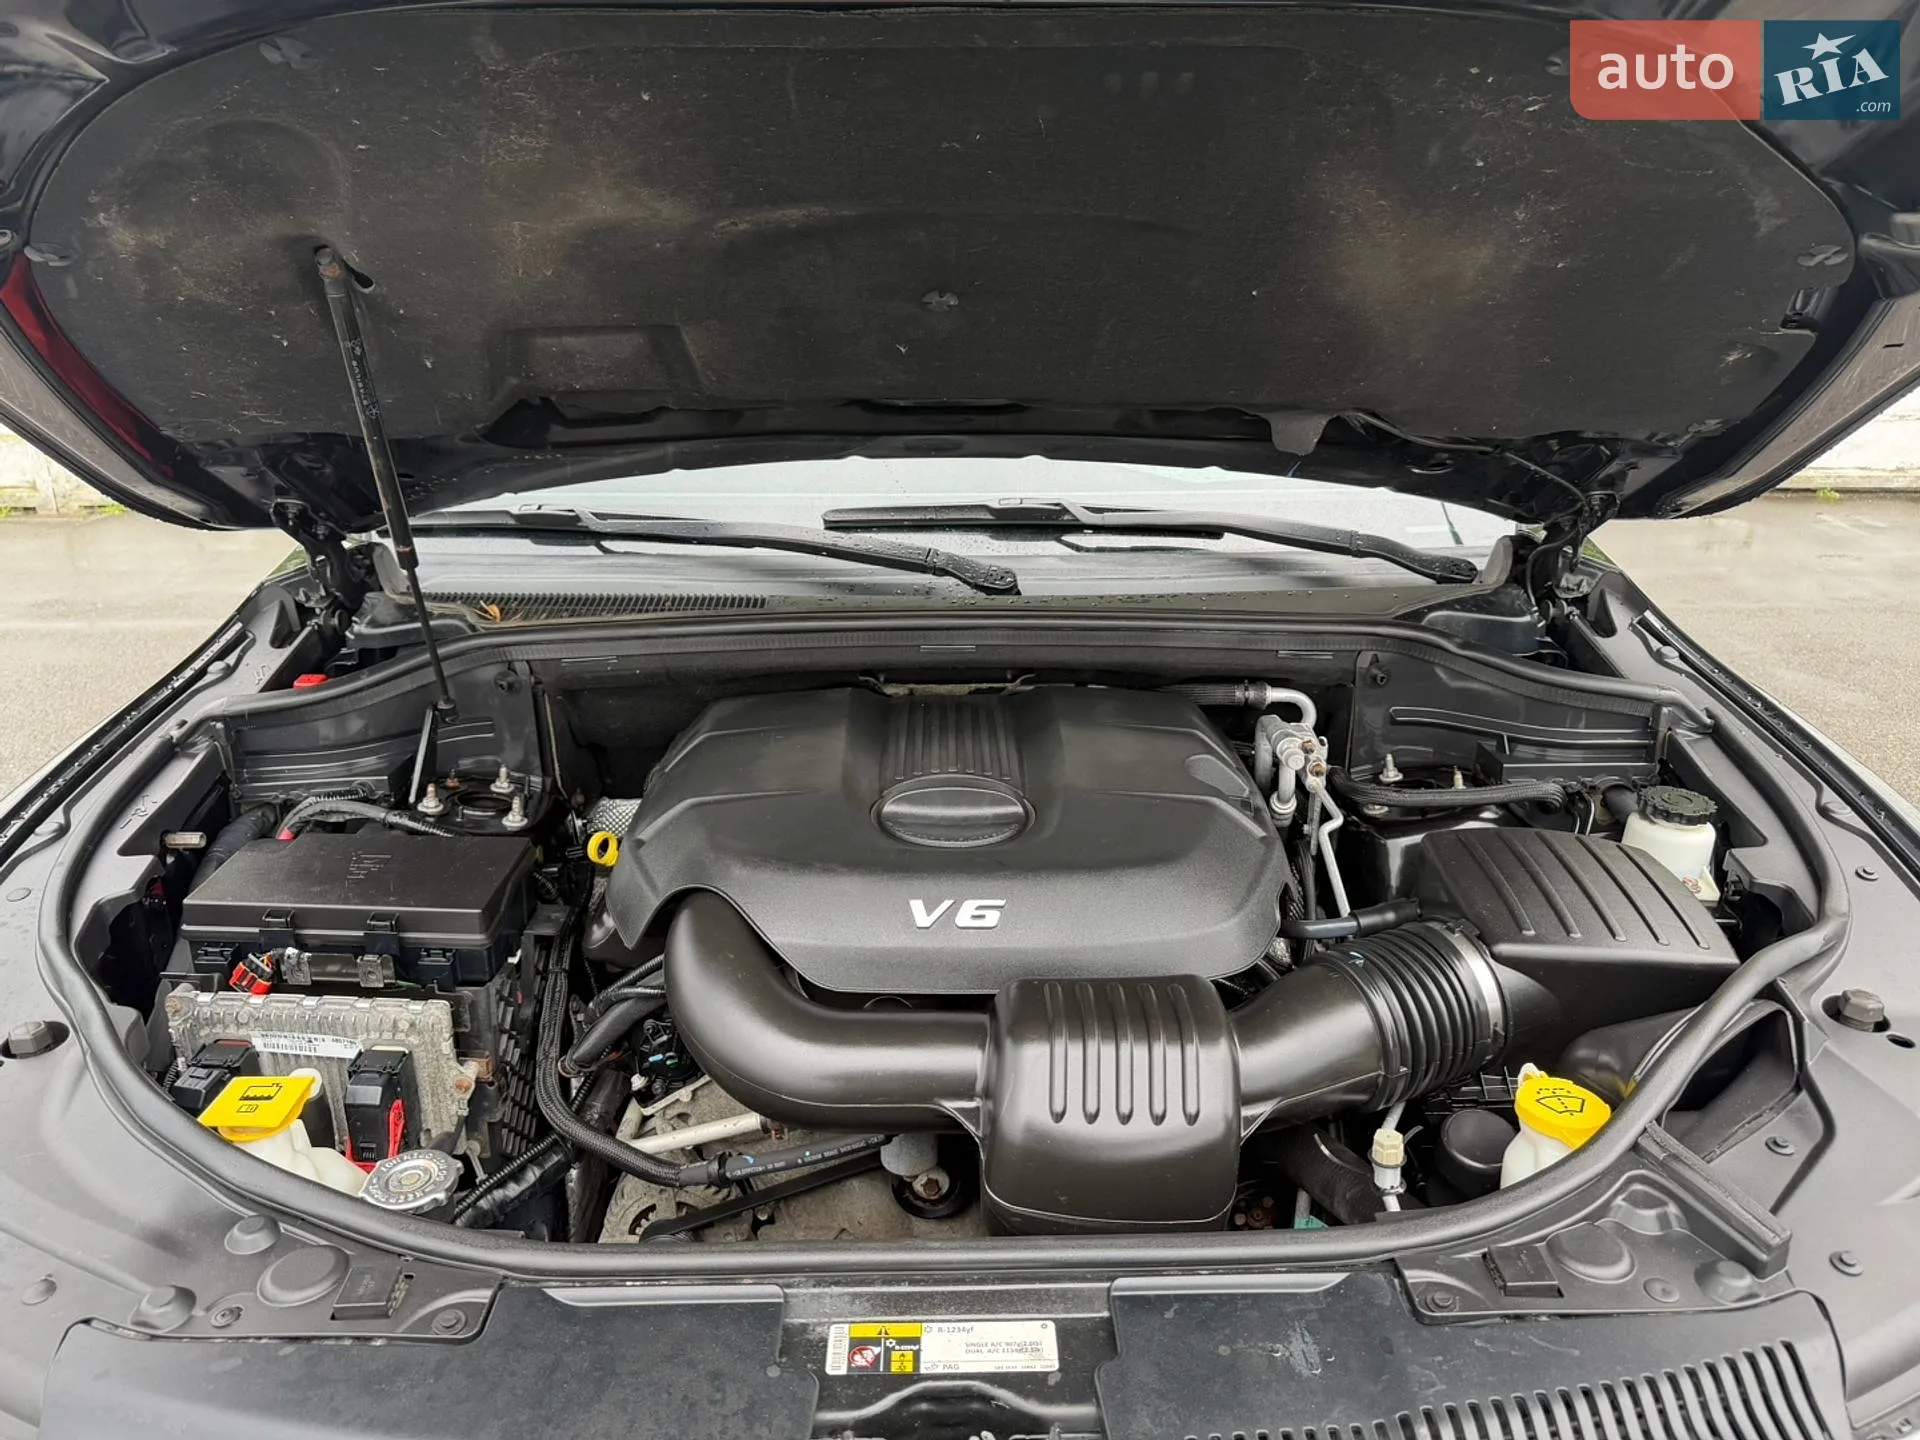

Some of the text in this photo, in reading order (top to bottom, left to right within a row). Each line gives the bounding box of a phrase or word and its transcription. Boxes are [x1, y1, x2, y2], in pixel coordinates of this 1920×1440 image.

[908, 899, 1007, 930] V6
[937, 1325, 974, 1335] R-1234yf
[942, 1363, 960, 1371] PAG
